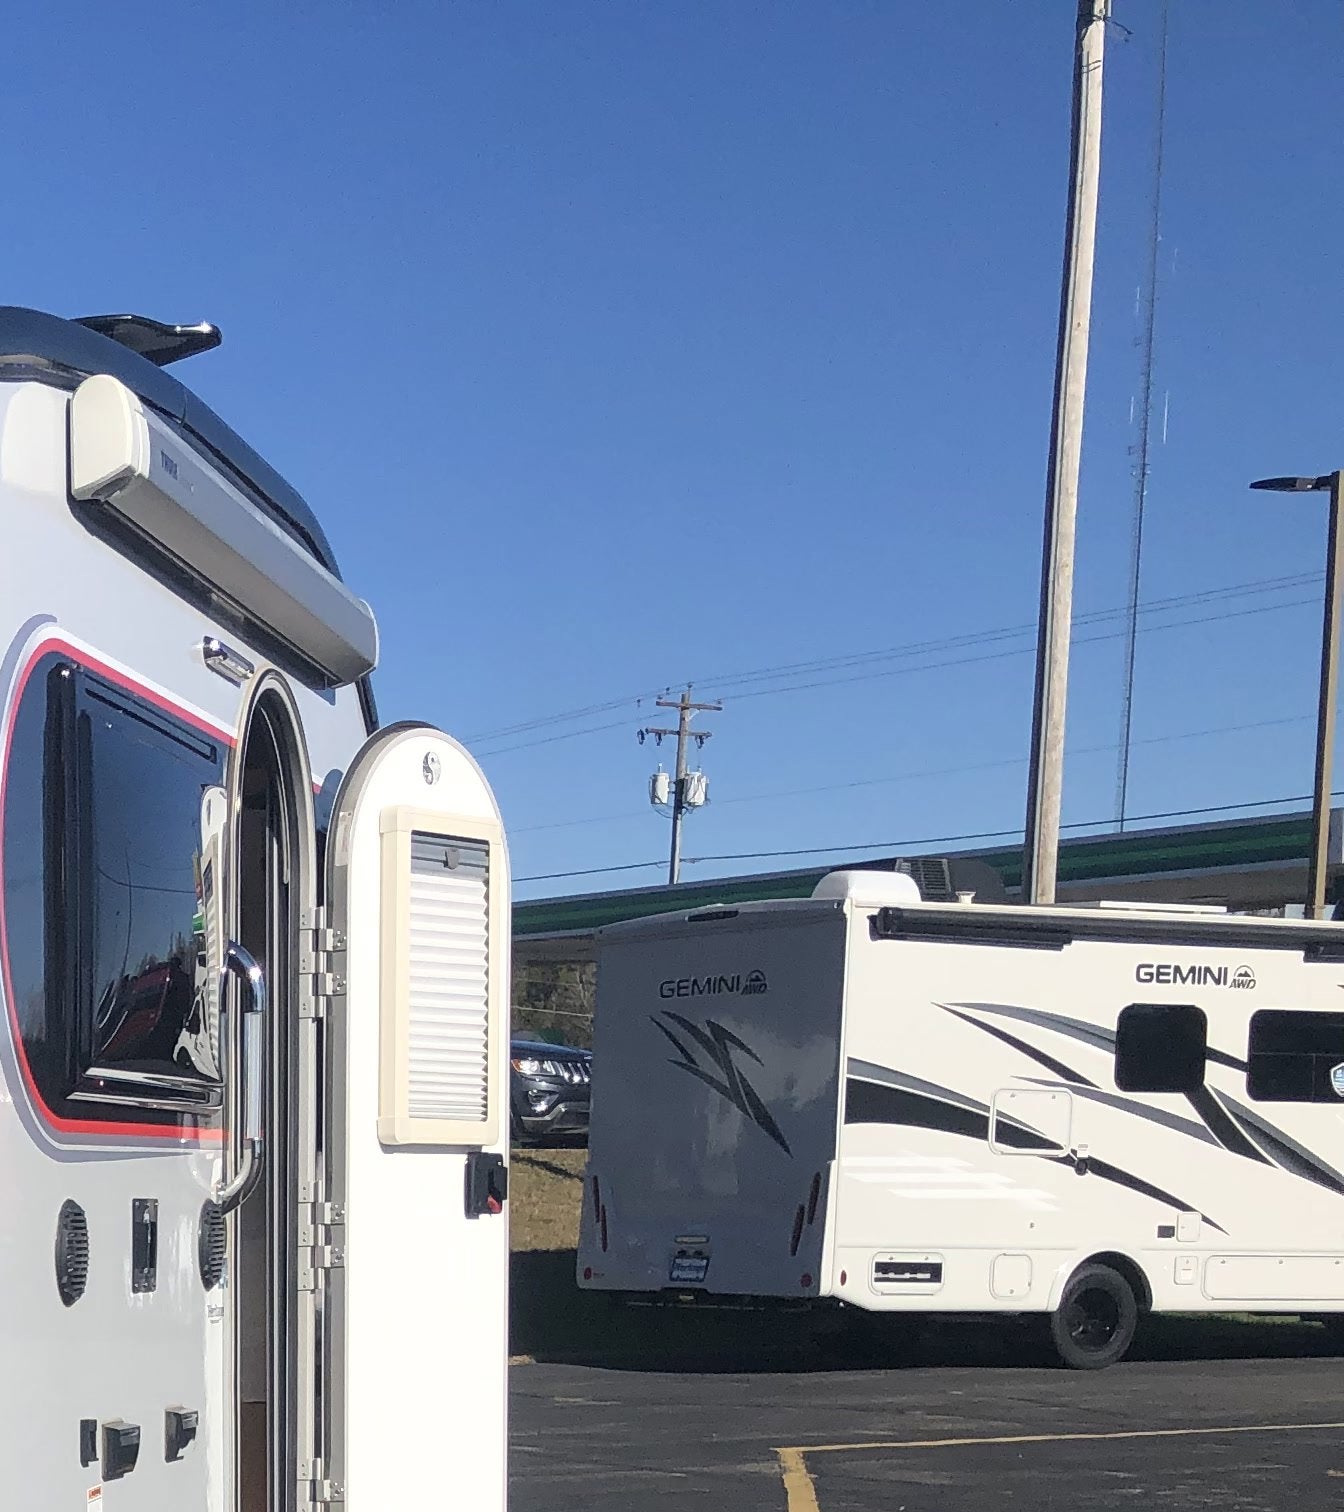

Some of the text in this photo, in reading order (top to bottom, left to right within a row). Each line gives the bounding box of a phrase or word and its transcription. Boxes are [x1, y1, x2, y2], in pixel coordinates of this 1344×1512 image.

[659, 974, 741, 999] GEMINI
[1135, 963, 1257, 990] GEMINI AWD
